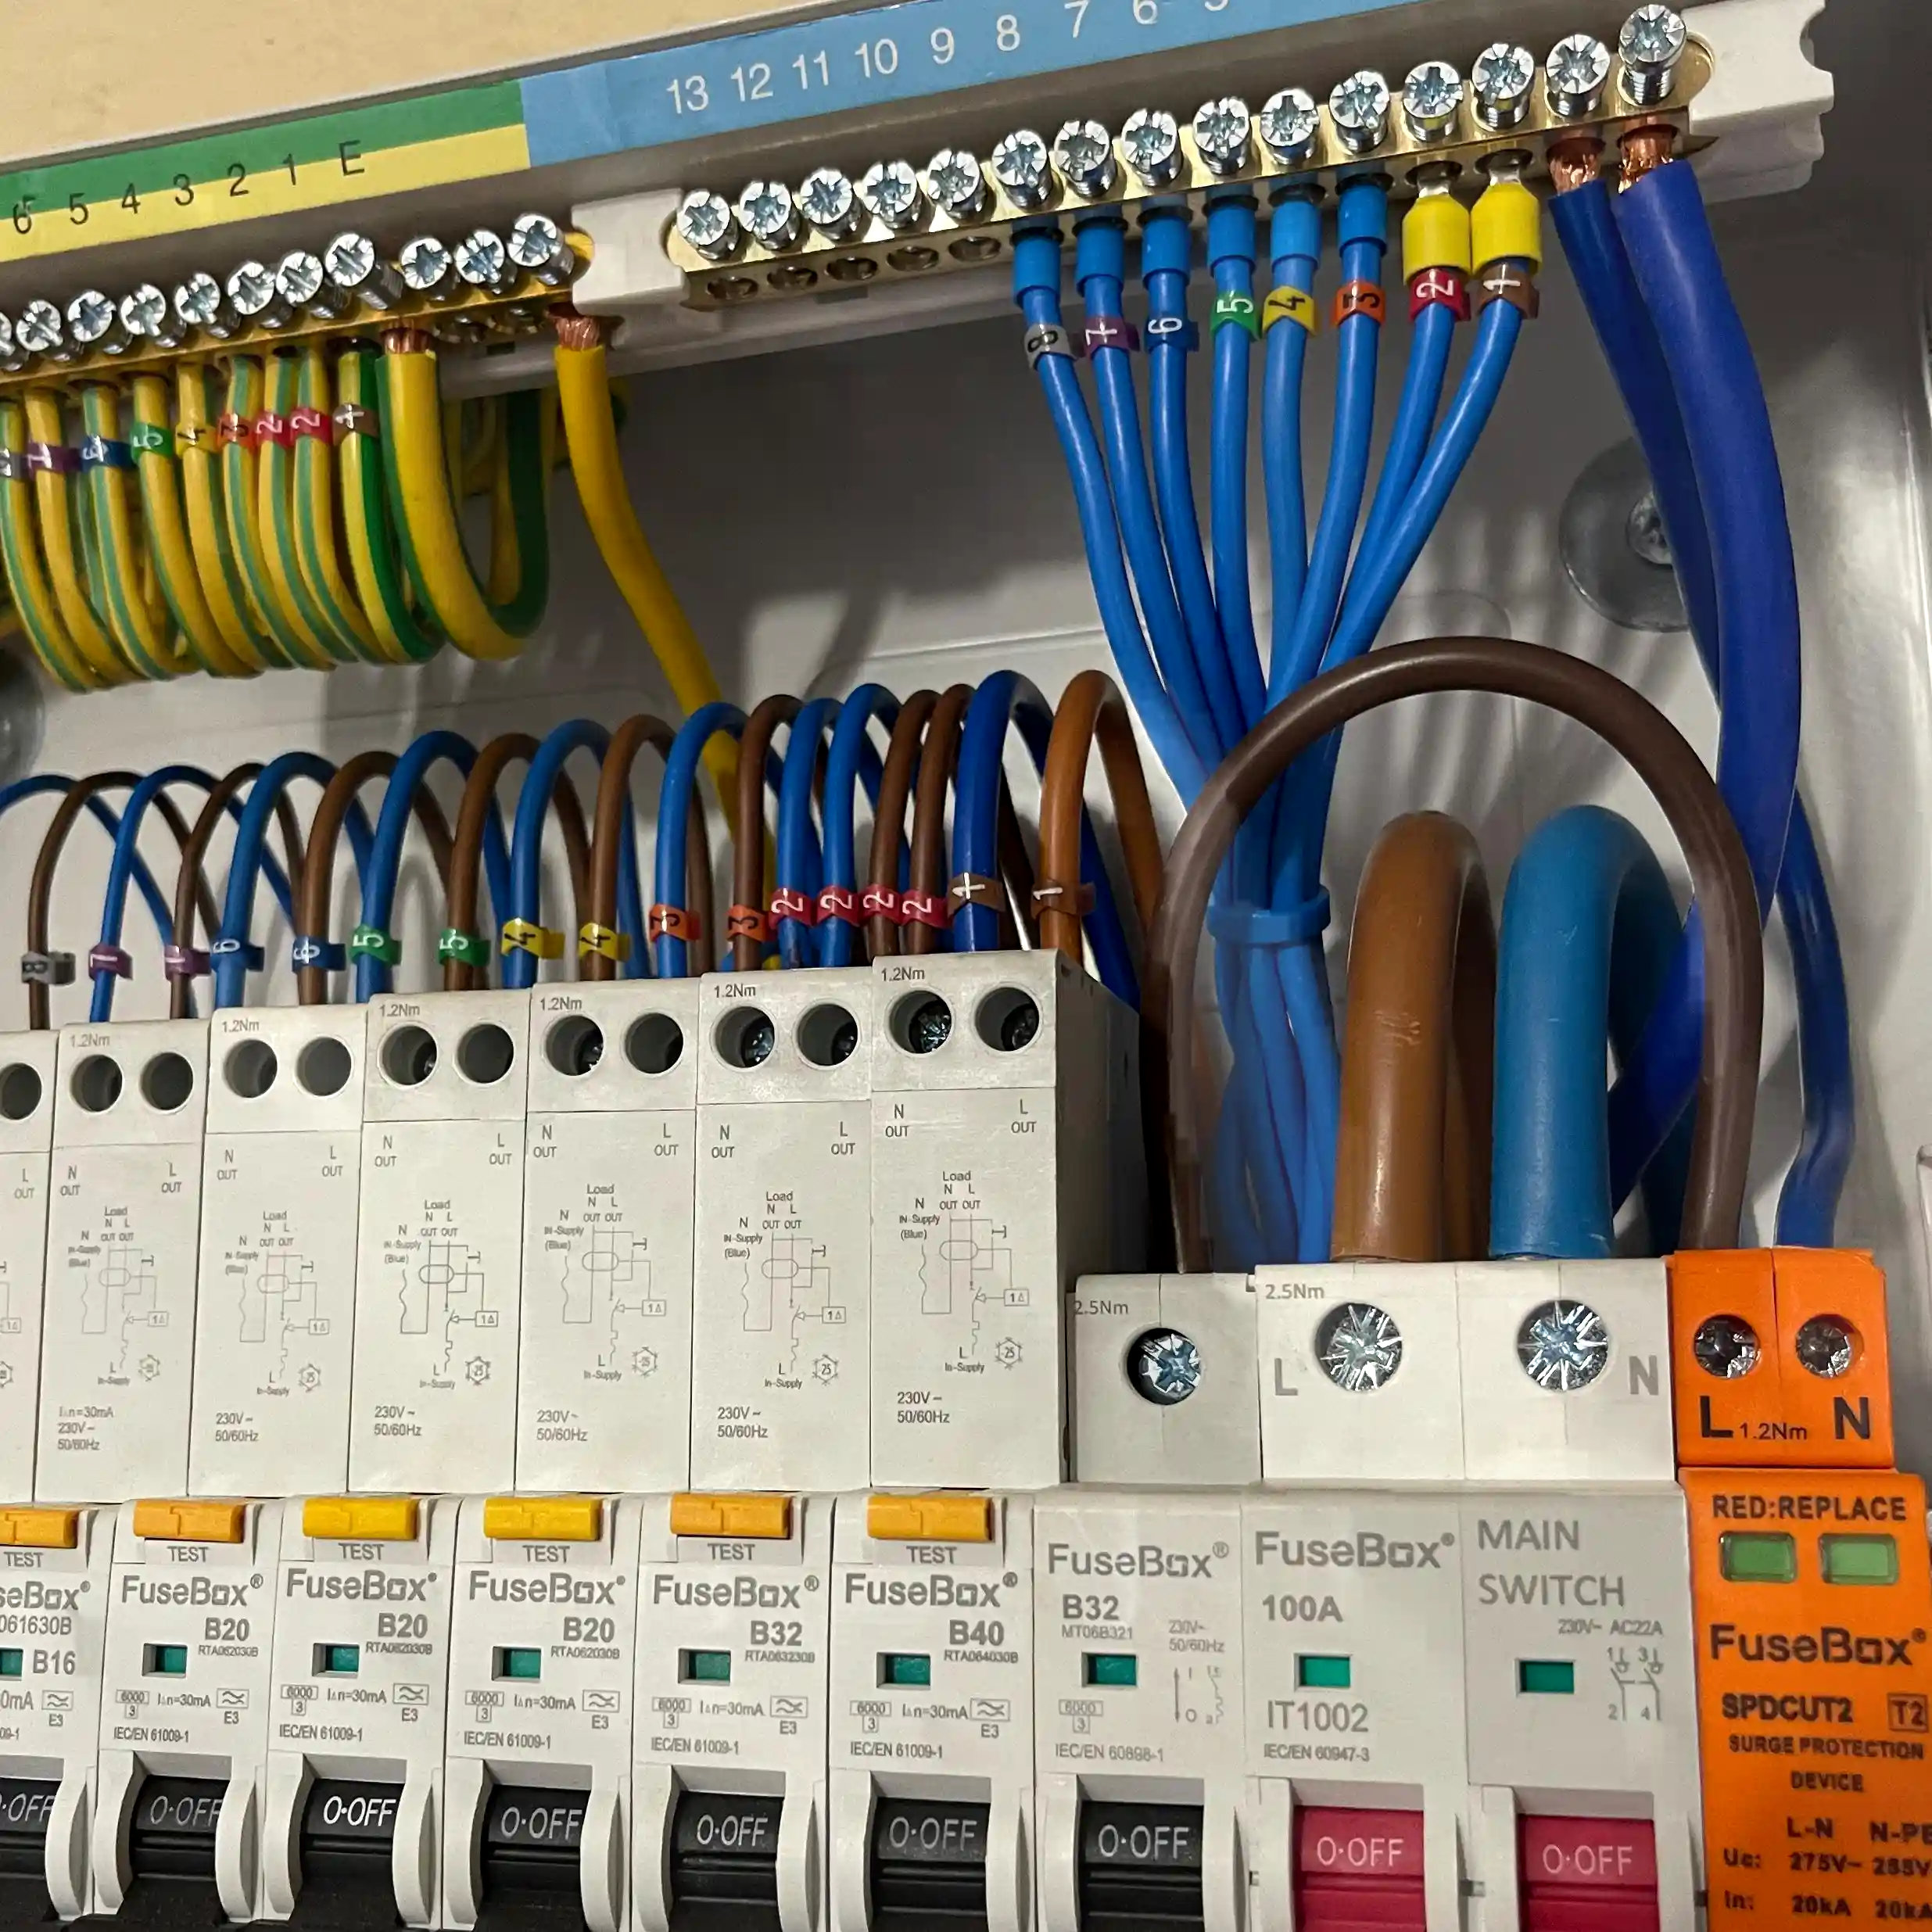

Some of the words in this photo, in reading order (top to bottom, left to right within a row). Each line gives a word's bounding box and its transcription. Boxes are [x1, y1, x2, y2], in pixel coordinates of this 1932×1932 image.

[667, 74, 708, 114] 13
[731, 63, 771, 102] 12
[792, 51, 830, 90] 11
[855, 38, 898, 77] 10
[930, 28, 955, 65] 9
[996, 15, 1020, 51] 8
[1064, 0, 1088, 38] 7
[69, 193, 88, 225] 5
[122, 182, 141, 214] 4
[174, 174, 195, 206] 3
[228, 163, 249, 196] 2
[283, 154, 298, 185] 1
[339, 140, 365, 175] E
[1416, 273, 1454, 299] 2
[1217, 292, 1255, 316] 5
[1273, 294, 1305, 311] 4
[1027, 328, 1059, 353] 8
[821, 893, 852, 912] 2
[863, 891, 894, 911] 2
[902, 898, 931, 915] 2
[353, 928, 383, 949] 5
[441, 929, 468, 953] 5
[880, 967, 925, 983] 1.2Nm
[714, 984, 756, 998] 1.2Nm
[379, 1002, 420, 1017] 1.2Nm
[537, 997, 582, 1011] 1.2Nm
[222, 1019, 260, 1033] 1.2Nm
[70, 1034, 110, 1048] 1.2Nm
[894, 1104, 905, 1120] N
[1020, 1099, 1028, 1115] L
[543, 1125, 552, 1140] N
[664, 1123, 671, 1138] L
[720, 1124, 729, 1140] N
[840, 1122, 848, 1138] L
[885, 1124, 909, 1138] OUT
[1012, 1120, 1037, 1134] OUT
[383, 1135, 392, 1149] N
[498, 1134, 505, 1148] L
[712, 1146, 735, 1158] OUT
[831, 1142, 856, 1156] OUT
[225, 1149, 234, 1163] N
[331, 1146, 337, 1160] L
[533, 1145, 557, 1158] OUT
[654, 1144, 679, 1156] OUT
[375, 1155, 396, 1167] OUT
[489, 1153, 512, 1165] OUT
[217, 1170, 238, 1181] OUT
[321, 1165, 343, 1177] OUT
[943, 1170, 972, 1182] Load
[587, 1184, 615, 1195] Load
[765, 1191, 794, 1203] Load
[1266, 1283, 1325, 1301] 2.5Nm
[1074, 1299, 1129, 1316] 2.5Nm
[1274, 1358, 1299, 1396] L
[1629, 1355, 1659, 1396] N
[897, 1410, 950, 1425] 50/60Hz
[1700, 1396, 1734, 1439] L
[1740, 1423, 1808, 1440] 1.2Nm
[1835, 1396, 1870, 1440] N
[374, 1424, 422, 1437] 50/60Hz
[536, 1428, 588, 1443] 50/60Hz
[717, 1425, 769, 1439] 50/60Hz
[1713, 1496, 1908, 1522] RED:REPLACE
[1479, 1519, 1580, 1551] MAIN
[4, 1551, 44, 1568] TEST
[167, 1546, 209, 1563] TEST
[339, 1543, 385, 1561] TEST
[522, 1545, 571, 1564] TEST
[708, 1543, 755, 1561] TEST
[907, 1546, 958, 1564] TEST
[1479, 1573, 1626, 1608] SWITCH
[1063, 1594, 1119, 1621] B32
[1263, 1595, 1343, 1622] 100A
[206, 1618, 250, 1642] B20
[378, 1613, 428, 1639] B20
[563, 1617, 615, 1643] B20
[751, 1620, 803, 1647] B32
[949, 1620, 1005, 1647] B40
[1610, 1619, 1663, 1636] AC22A
[33, 1649, 76, 1675] B16
[224, 1709, 239, 1725] E3
[401, 1707, 419, 1723] E3
[1267, 1700, 1369, 1733] IT1002
[1722, 1692, 1854, 1723] SPDCUT2
[1893, 1699, 1924, 1726] T2
[592, 1715, 610, 1730] E3
[780, 1720, 798, 1736] E3
[113, 1726, 149, 1742] IEC/EN
[280, 1724, 317, 1740] IEC/EN
[464, 1731, 504, 1748] IEC/EN
[980, 1724, 1000, 1739] E3
[651, 1737, 692, 1754] IEC/EN
[851, 1741, 894, 1758] IEC/EN
[1055, 1743, 1105, 1760] IEC/EN
[1264, 1744, 1312, 1761] IEC/EN
[1729, 1733, 1794, 1755] SURGE
[1799, 1737, 1924, 1761] PROTECTION
[1791, 1770, 1864, 1793] DEVICE
[1787, 1816, 1833, 1838] L-N
[1792, 1894, 1852, 1917] 20kA
